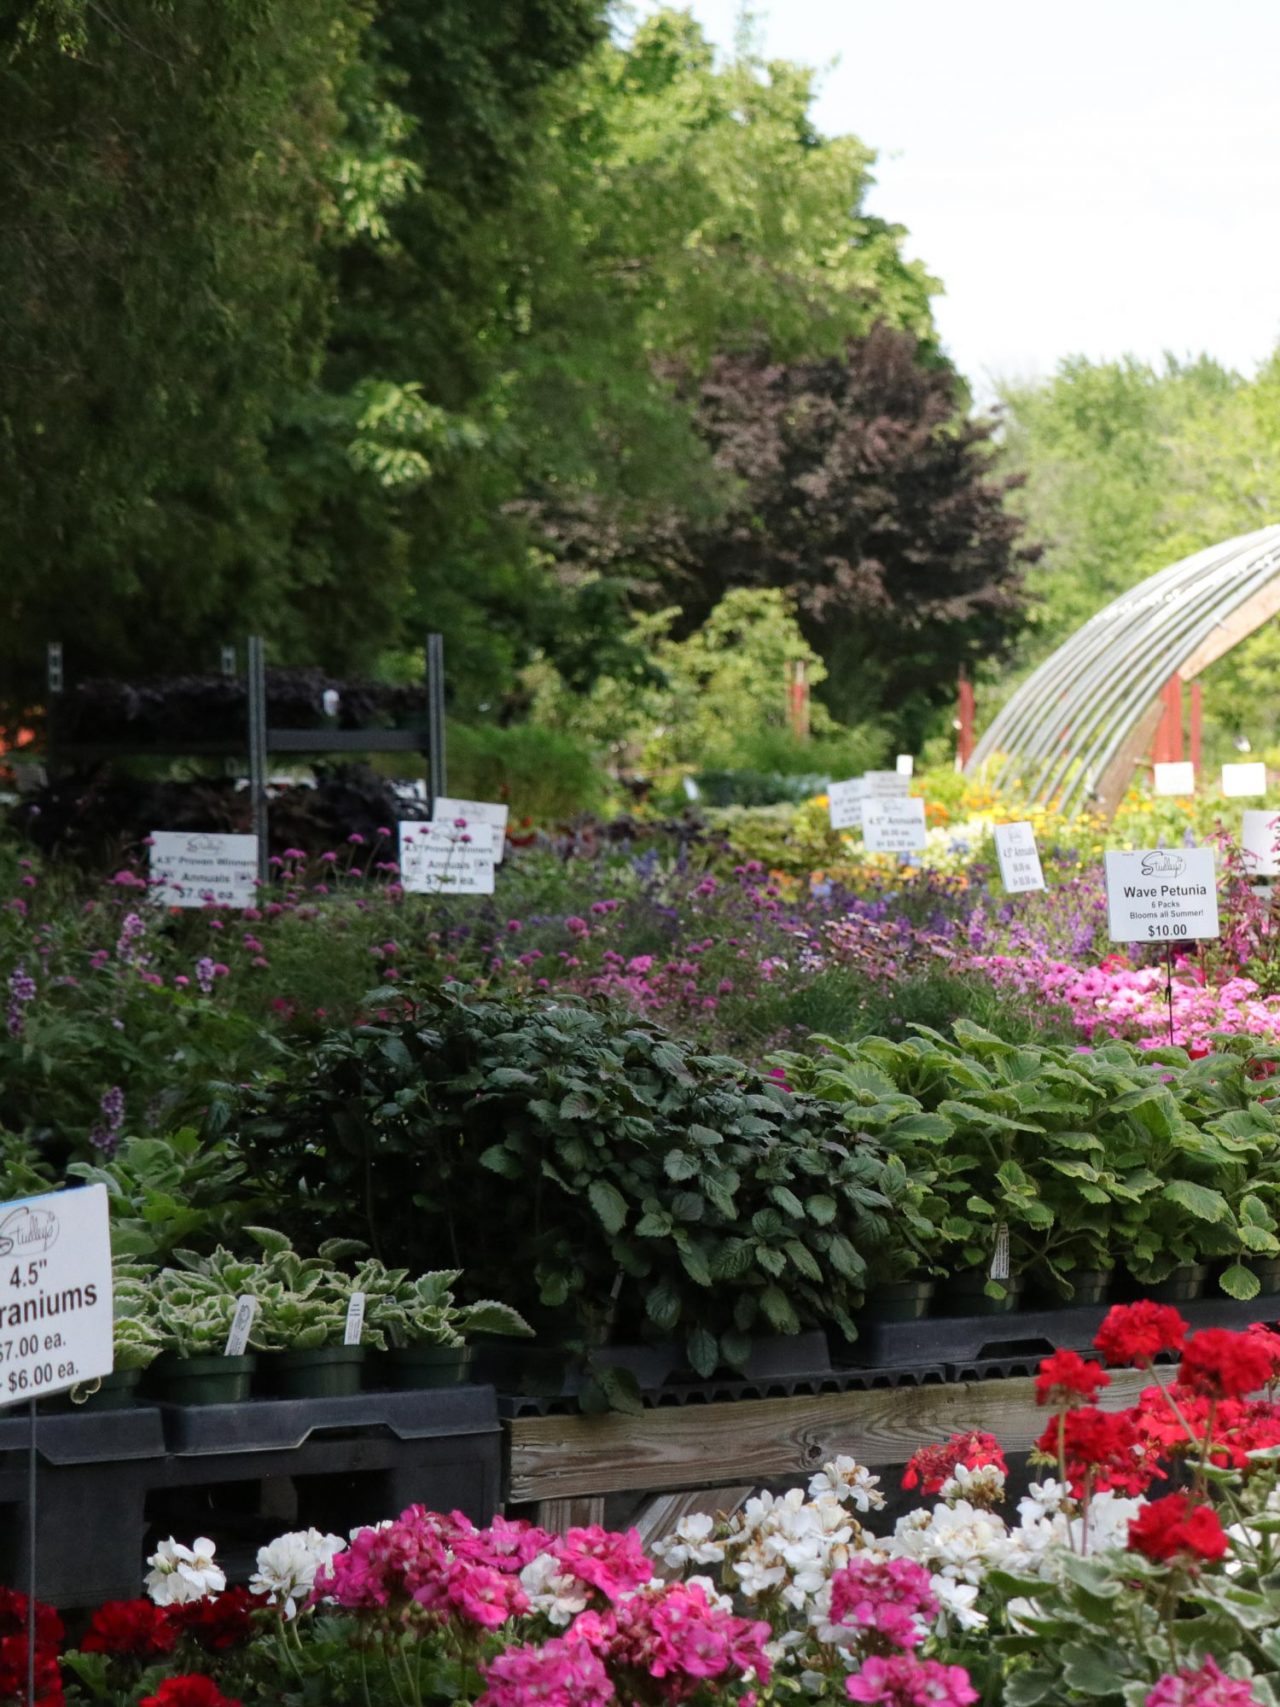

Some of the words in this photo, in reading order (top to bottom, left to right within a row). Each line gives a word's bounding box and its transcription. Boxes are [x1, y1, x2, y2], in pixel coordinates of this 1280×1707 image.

[179, 856, 214, 865] Proven
[428, 860, 470, 870] Annuals
[182, 872, 230, 883] Annuals
[1124, 886, 1157, 898] Wave
[1160, 884, 1207, 897] Petunia
[1151, 901, 1156, 909] 6
[1158, 900, 1180, 909] Packs
[1129, 911, 1158, 920] Blooms
[1160, 910, 1169, 918] all
[1171, 909, 1204, 918] Summer!
[1148, 924, 1187, 937] $10.00
[9, 1259, 48, 1290] 4.5"
[0, 1283, 97, 1329] raniums
[44, 1332, 66, 1351] ea.
[9, 1362, 53, 1393] $6.00
[58, 1360, 79, 1378] ea.
